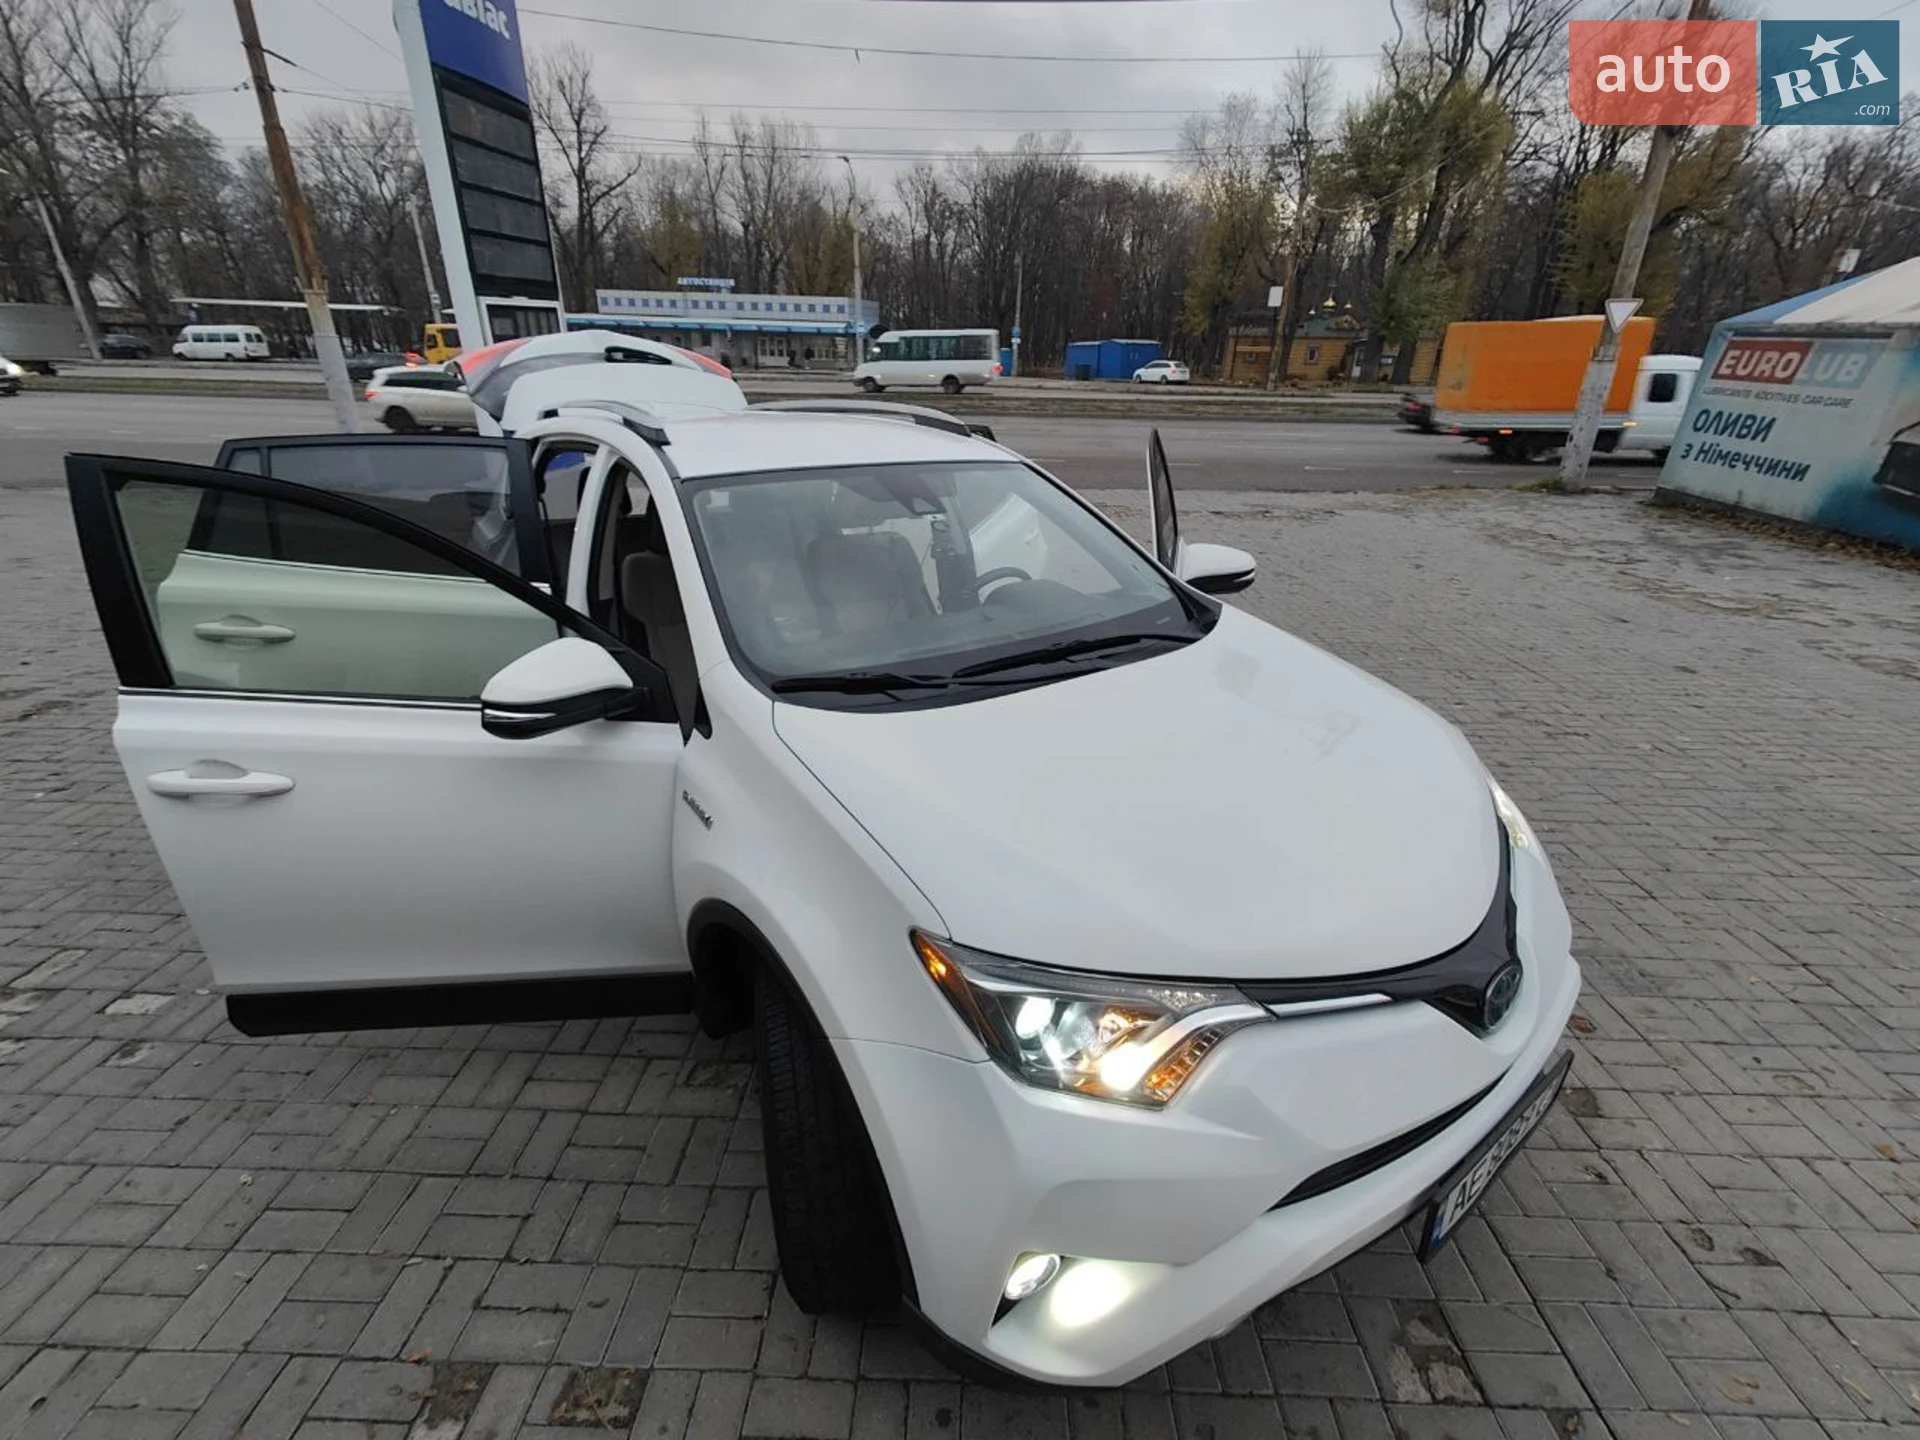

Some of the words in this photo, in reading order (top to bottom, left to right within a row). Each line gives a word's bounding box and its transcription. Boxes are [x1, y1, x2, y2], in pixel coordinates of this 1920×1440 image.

[1692, 408, 1777, 442] ОЛИВИ
[1681, 443, 1693, 459] з
[1694, 441, 1811, 481] Німеччини
